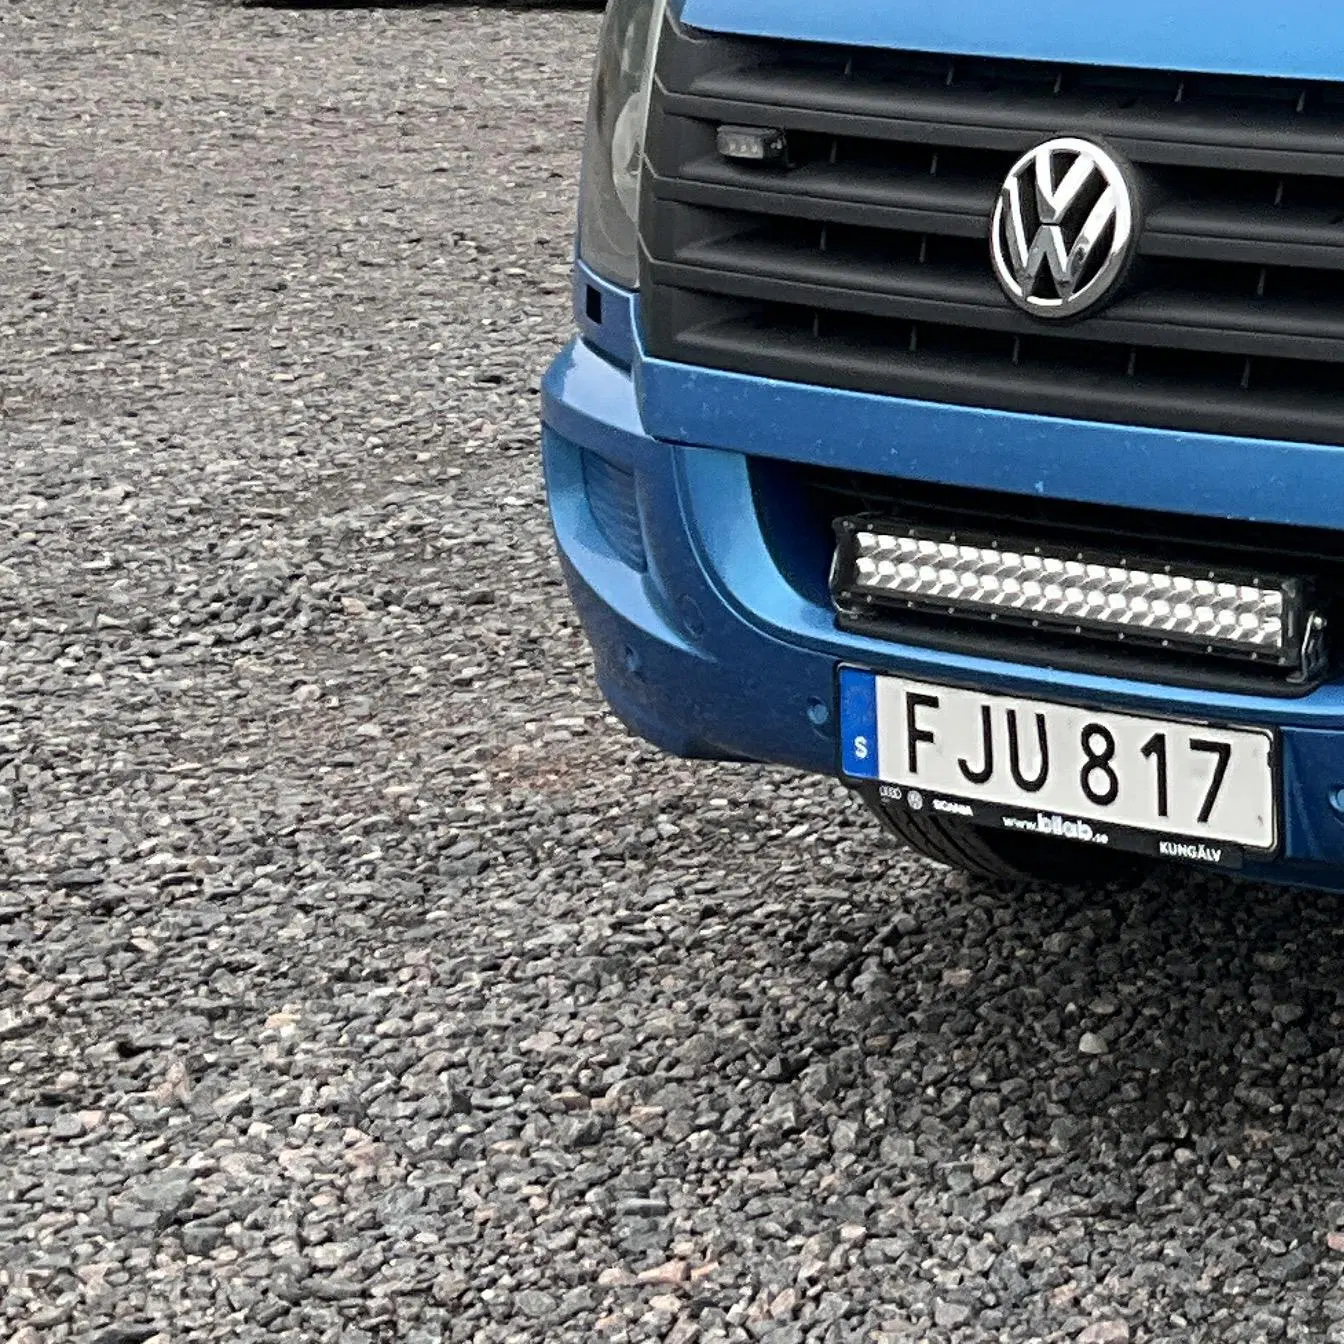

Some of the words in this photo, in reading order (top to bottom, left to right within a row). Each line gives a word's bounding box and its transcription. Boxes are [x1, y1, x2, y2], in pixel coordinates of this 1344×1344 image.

[991, 137, 1132, 318] VW
[854, 735, 869, 758] S
[906, 692, 1049, 792] FJU
[1080, 723, 1231, 823] 817
[1002, 813, 1109, 844] www.bilab.se
[1159, 842, 1222, 862] KUNGÄLV
